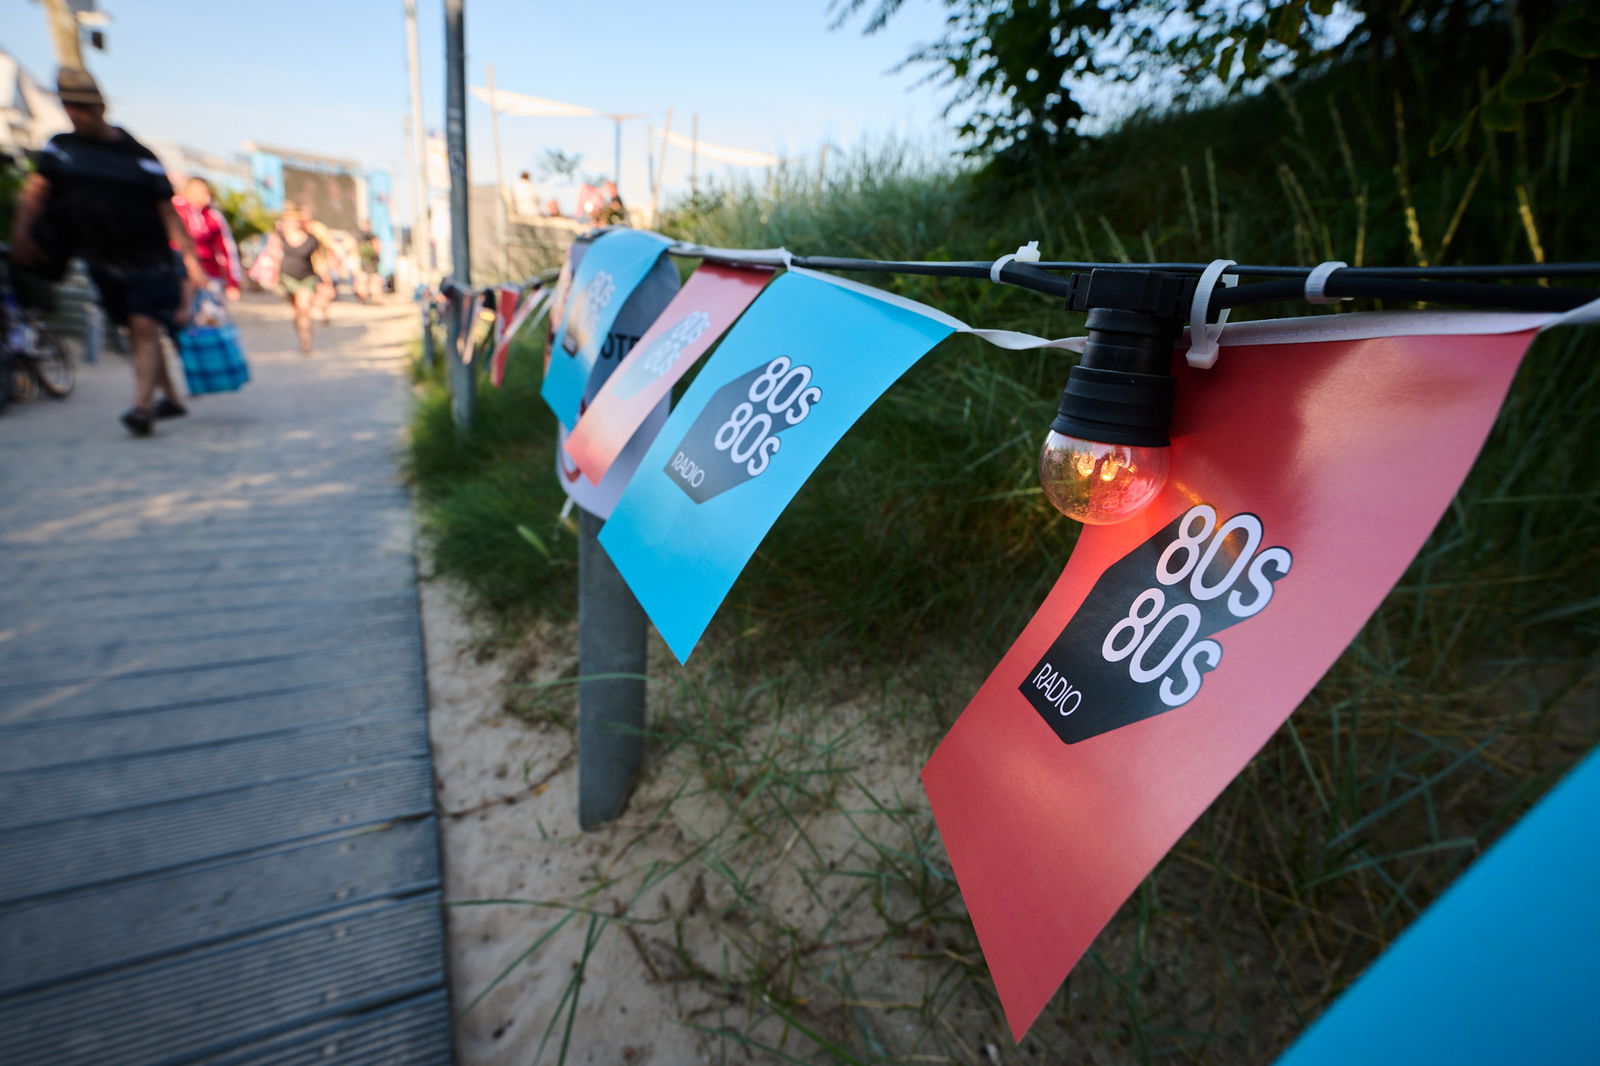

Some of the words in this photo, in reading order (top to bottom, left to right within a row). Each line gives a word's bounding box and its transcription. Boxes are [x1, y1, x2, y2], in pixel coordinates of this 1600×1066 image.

[748, 355, 823, 425] 80s
[671, 451, 705, 488] RADIO
[714, 402, 781, 476] 80s
[1155, 504, 1292, 618] 80s
[1101, 587, 1222, 707] 80s
[1032, 662, 1082, 717] RADIO
